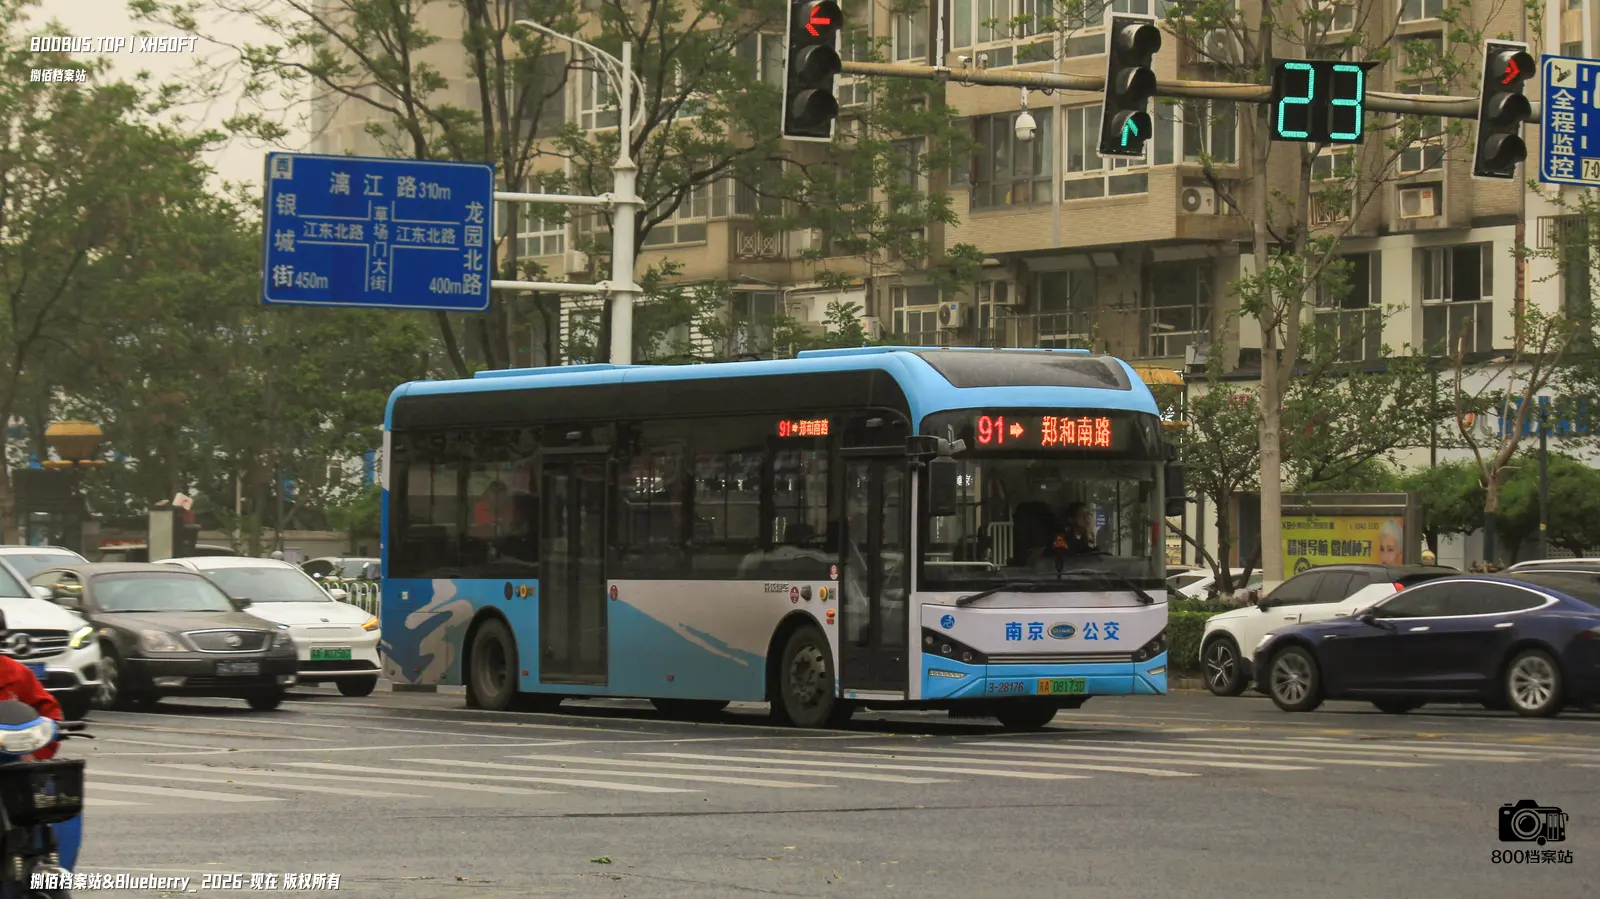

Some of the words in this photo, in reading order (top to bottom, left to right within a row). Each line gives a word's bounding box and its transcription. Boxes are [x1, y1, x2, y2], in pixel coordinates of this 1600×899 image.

[1278, 63, 1363, 139] 23
[1550, 89, 1576, 179] 全程监控
[329, 171, 418, 199] 漓江路
[418, 181, 451, 200] 310m
[272, 192, 297, 288] 银城街
[302, 221, 364, 240] 江东北路
[396, 226, 456, 245] 江东北路
[370, 206, 389, 292] 草场门大街
[462, 201, 485, 296] 龙园北路
[295, 272, 329, 290] 450m
[429, 277, 463, 294] 400m
[779, 419, 791, 437] 91
[977, 415, 1005, 444] 91
[1041, 415, 1111, 447] 郑和南路
[1005, 621, 1044, 641] 南京
[1083, 621, 1120, 640] 公交
[989, 681, 1024, 693] 3-28176
